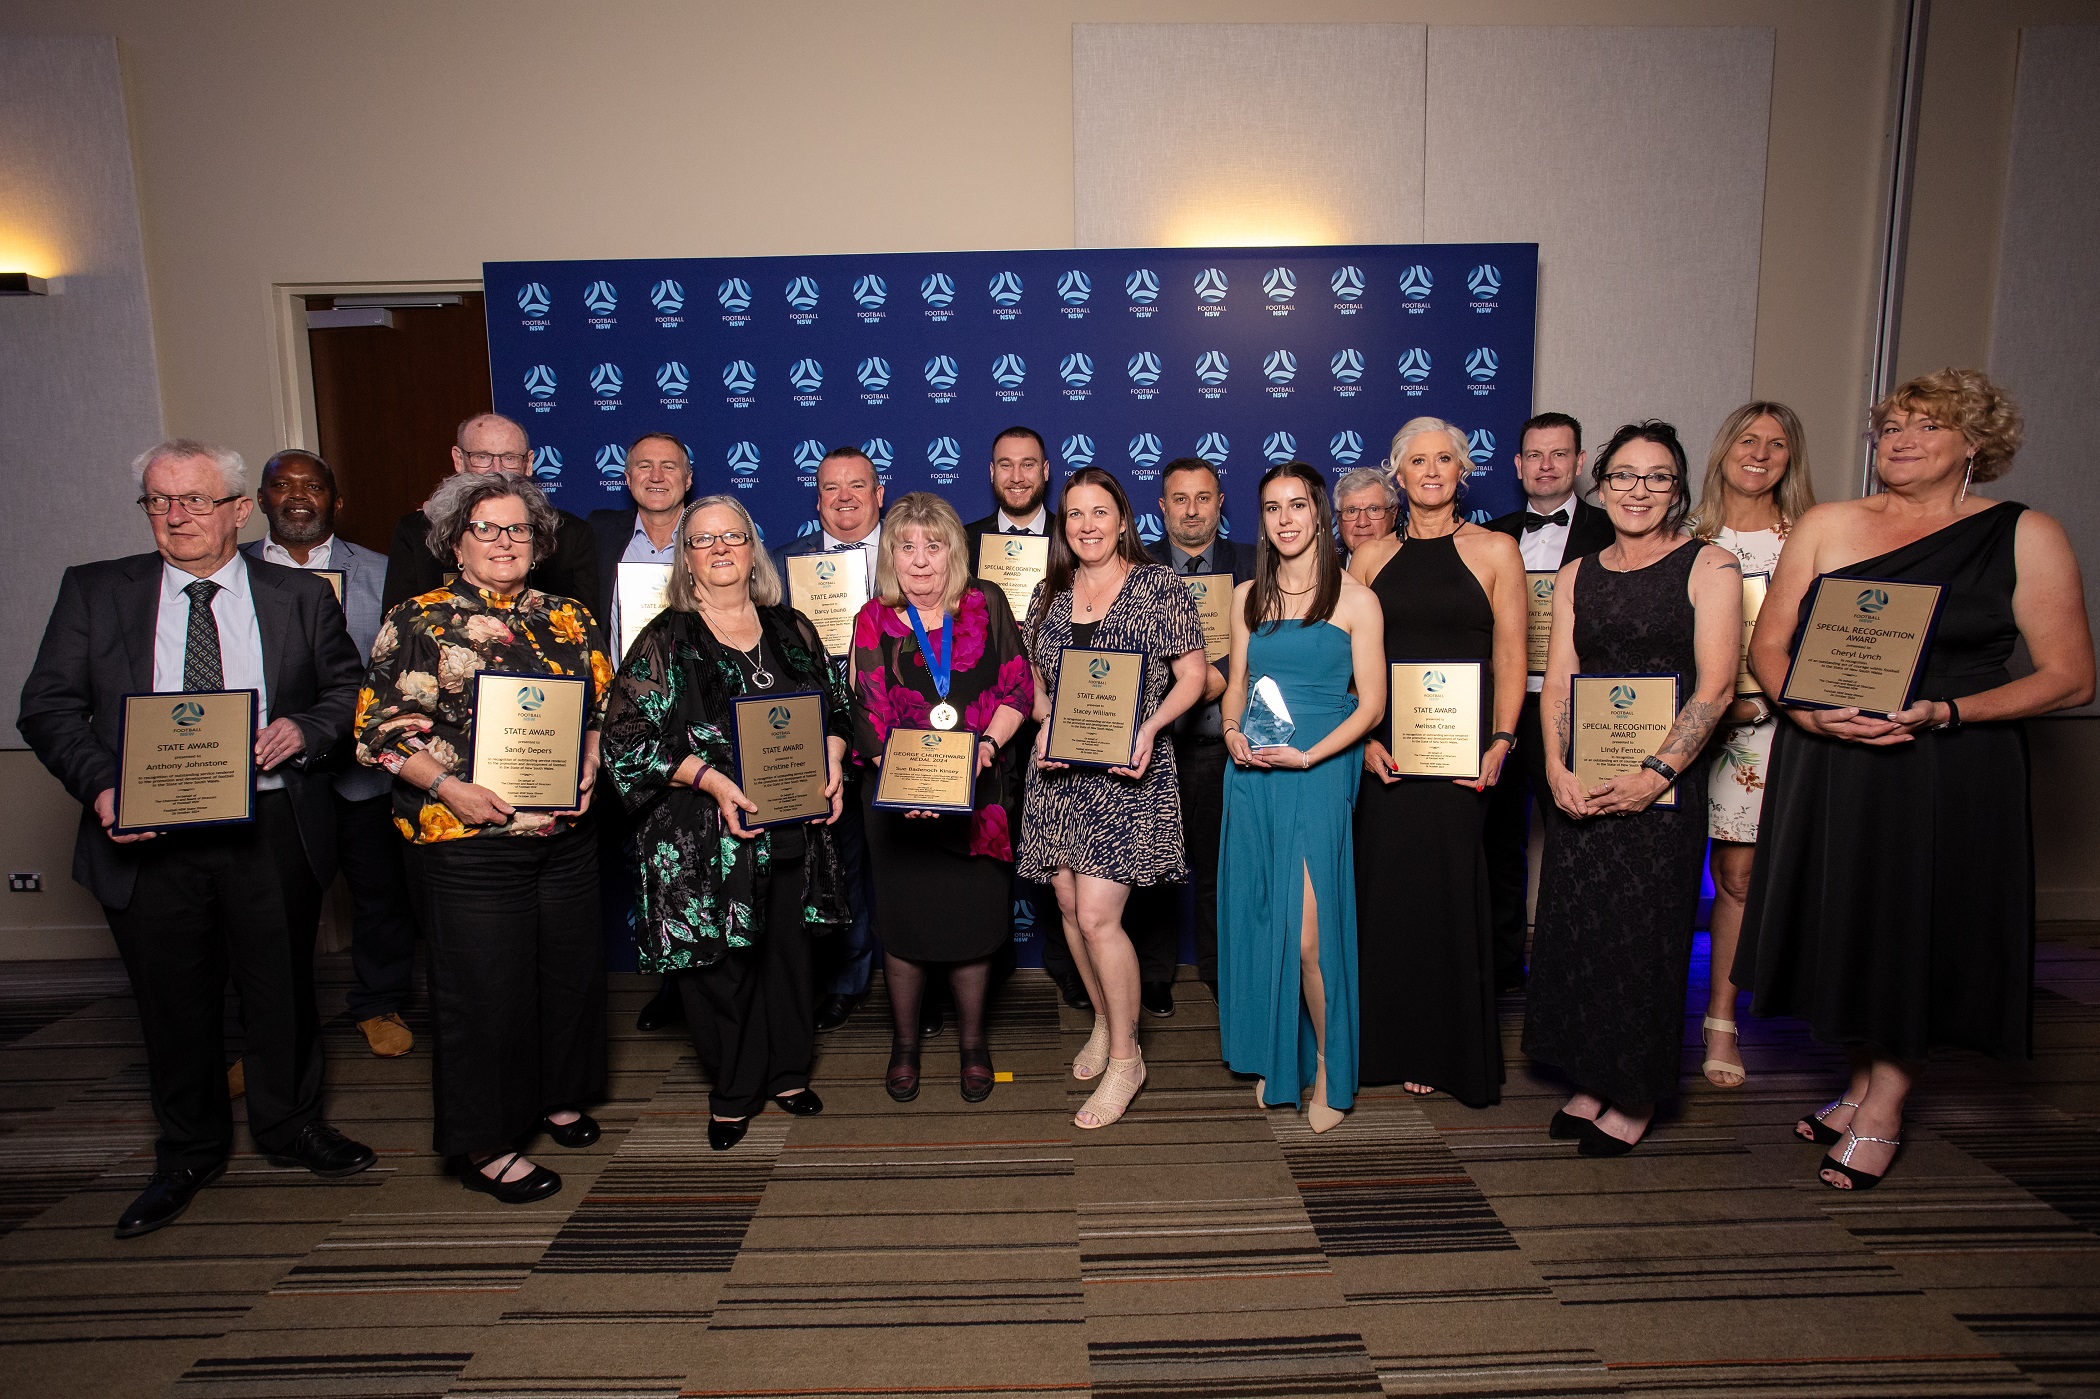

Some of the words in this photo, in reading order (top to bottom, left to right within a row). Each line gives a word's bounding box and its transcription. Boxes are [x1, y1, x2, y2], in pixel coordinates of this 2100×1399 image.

[1816, 623, 1849, 632] SPECIAL
[1852, 626, 1915, 640] RECOGNITION
[1846, 635, 1876, 644] AWARD
[1831, 648, 1856, 658] Cheryl
[1858, 652, 1881, 660] Lynch
[1093, 709, 1116, 717] Williams
[157, 744, 185, 752] STATE
[187, 742, 219, 750] AWARD
[505, 746, 525, 754] Sandy
[763, 746, 781, 754] STATE
[783, 743, 803, 751] AWARD
[146, 763, 182, 771] Anthony
[185, 760, 228, 768] Johnstone
[763, 763, 789, 771] Christine
